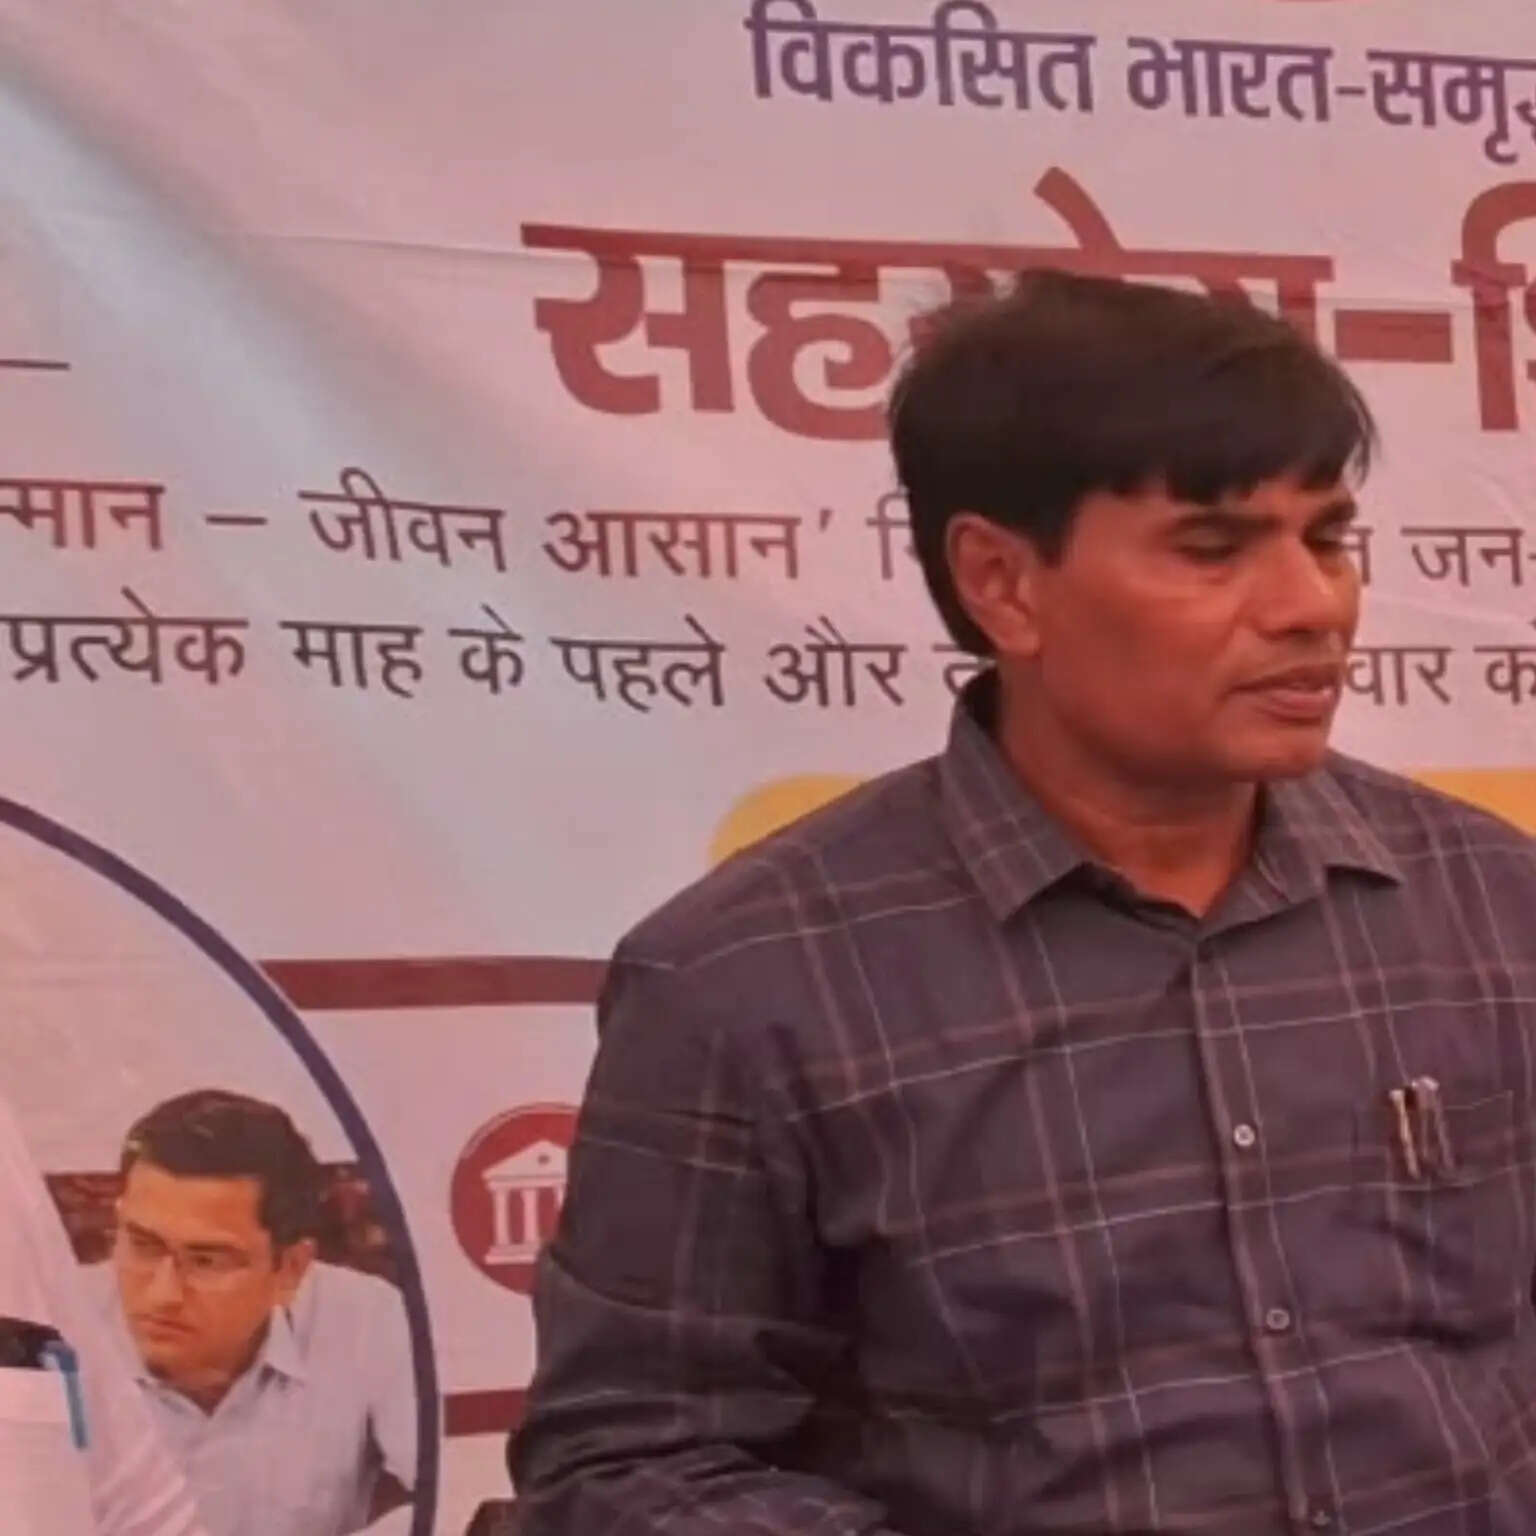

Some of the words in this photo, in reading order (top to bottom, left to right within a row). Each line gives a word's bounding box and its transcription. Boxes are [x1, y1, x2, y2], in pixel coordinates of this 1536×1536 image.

[743, 0, 1098, 114] विकसित
[296, 466, 508, 574] जीवन
[3, 586, 250, 686] प्रत्येक
[280, 619, 425, 700] माह
[446, 608, 525, 696] के
[548, 613, 727, 714] पहले
[762, 614, 909, 709] और
